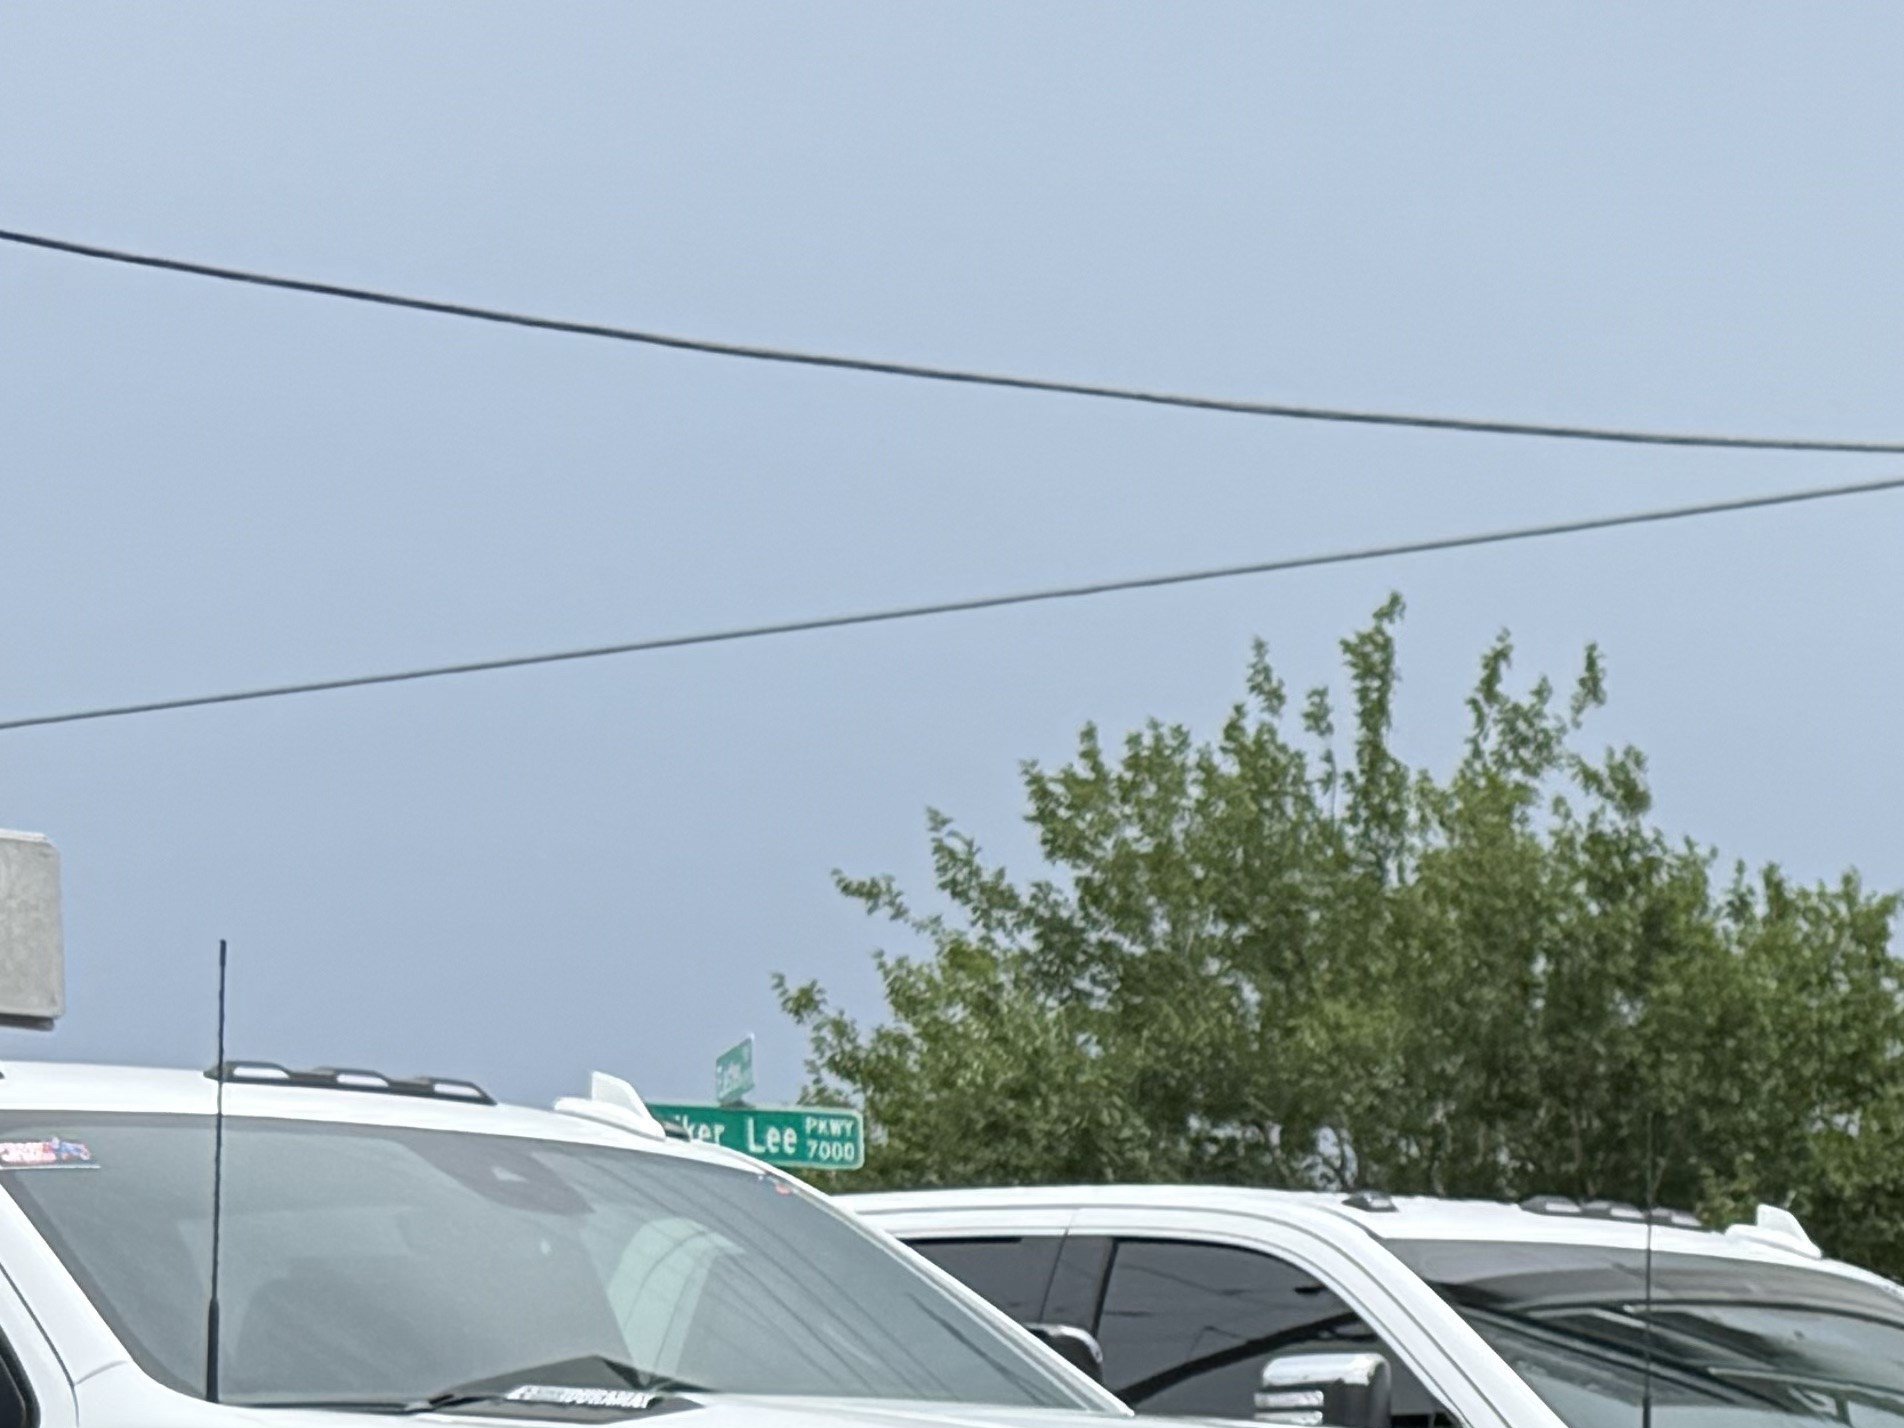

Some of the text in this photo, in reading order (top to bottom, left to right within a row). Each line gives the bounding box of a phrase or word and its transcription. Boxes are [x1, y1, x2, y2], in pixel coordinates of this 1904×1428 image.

[748, 1117, 798, 1155] Lee
[806, 1117, 854, 1137] PKWY
[806, 1141, 855, 1161] 7000
